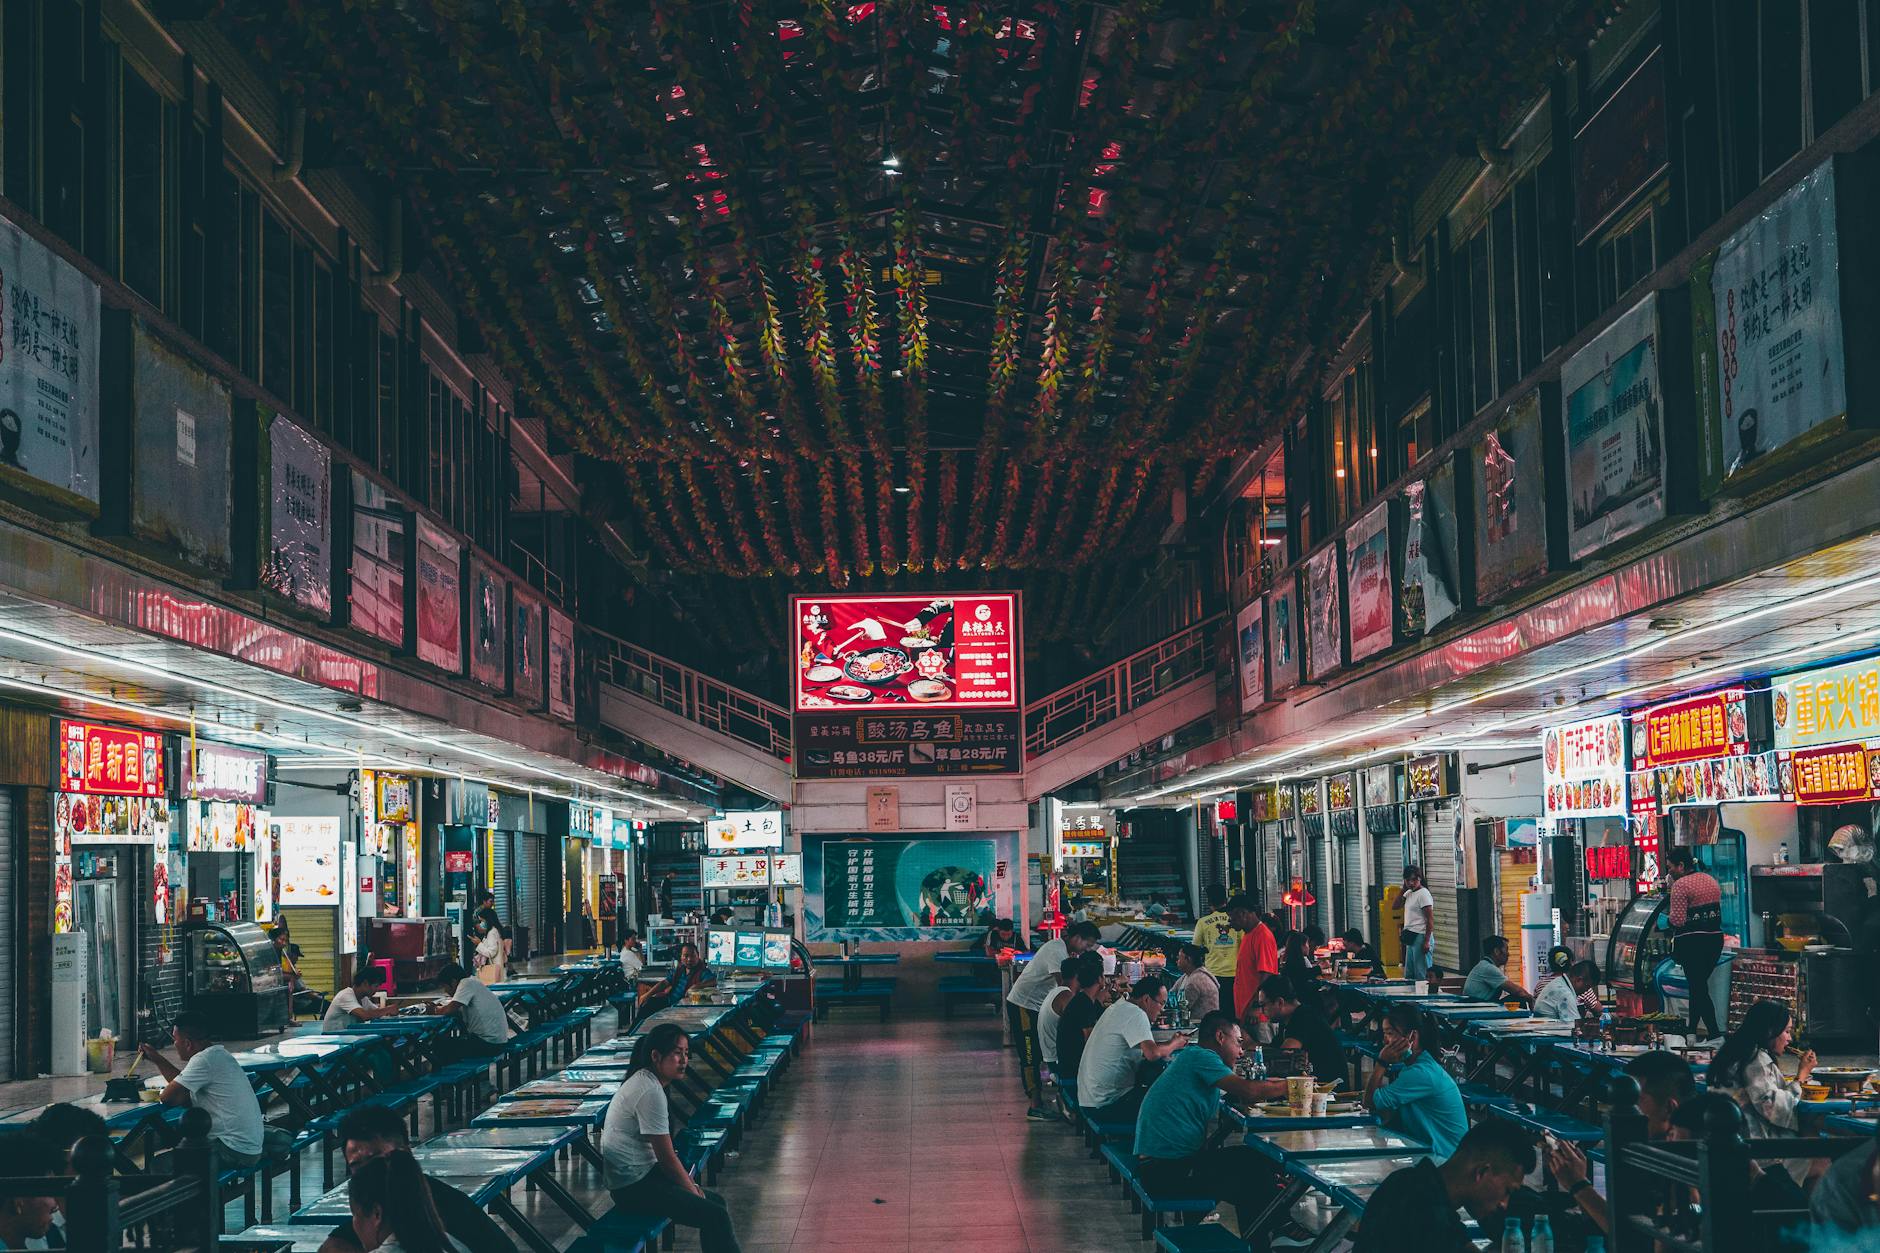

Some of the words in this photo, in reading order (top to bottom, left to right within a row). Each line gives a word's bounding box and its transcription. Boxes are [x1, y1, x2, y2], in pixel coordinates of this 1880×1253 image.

[1741, 245, 1810, 312] 饮食是一种文化
[1743, 276, 1811, 344] 节约是一种文明
[11, 284, 79, 350] 饮食是一种文化
[12, 319, 79, 384] 节约是一种文明
[867, 719, 954, 740] 酸汤乌鱼
[1650, 704, 1725, 756] 正宗杨林酸菜鱼
[1796, 669, 1879, 736] 重庆火锅
[87, 736, 139, 783] 鼎新园
[833, 750, 904, 765] 乌鱼38元/斤
[935, 747, 1007, 760] 草鱼28元/斤
[717, 860, 786, 871] 手工饺子
[847, 849, 859, 916] 守护国家卫生城市
[862, 849, 875, 916] 开展爱国卫生运动
